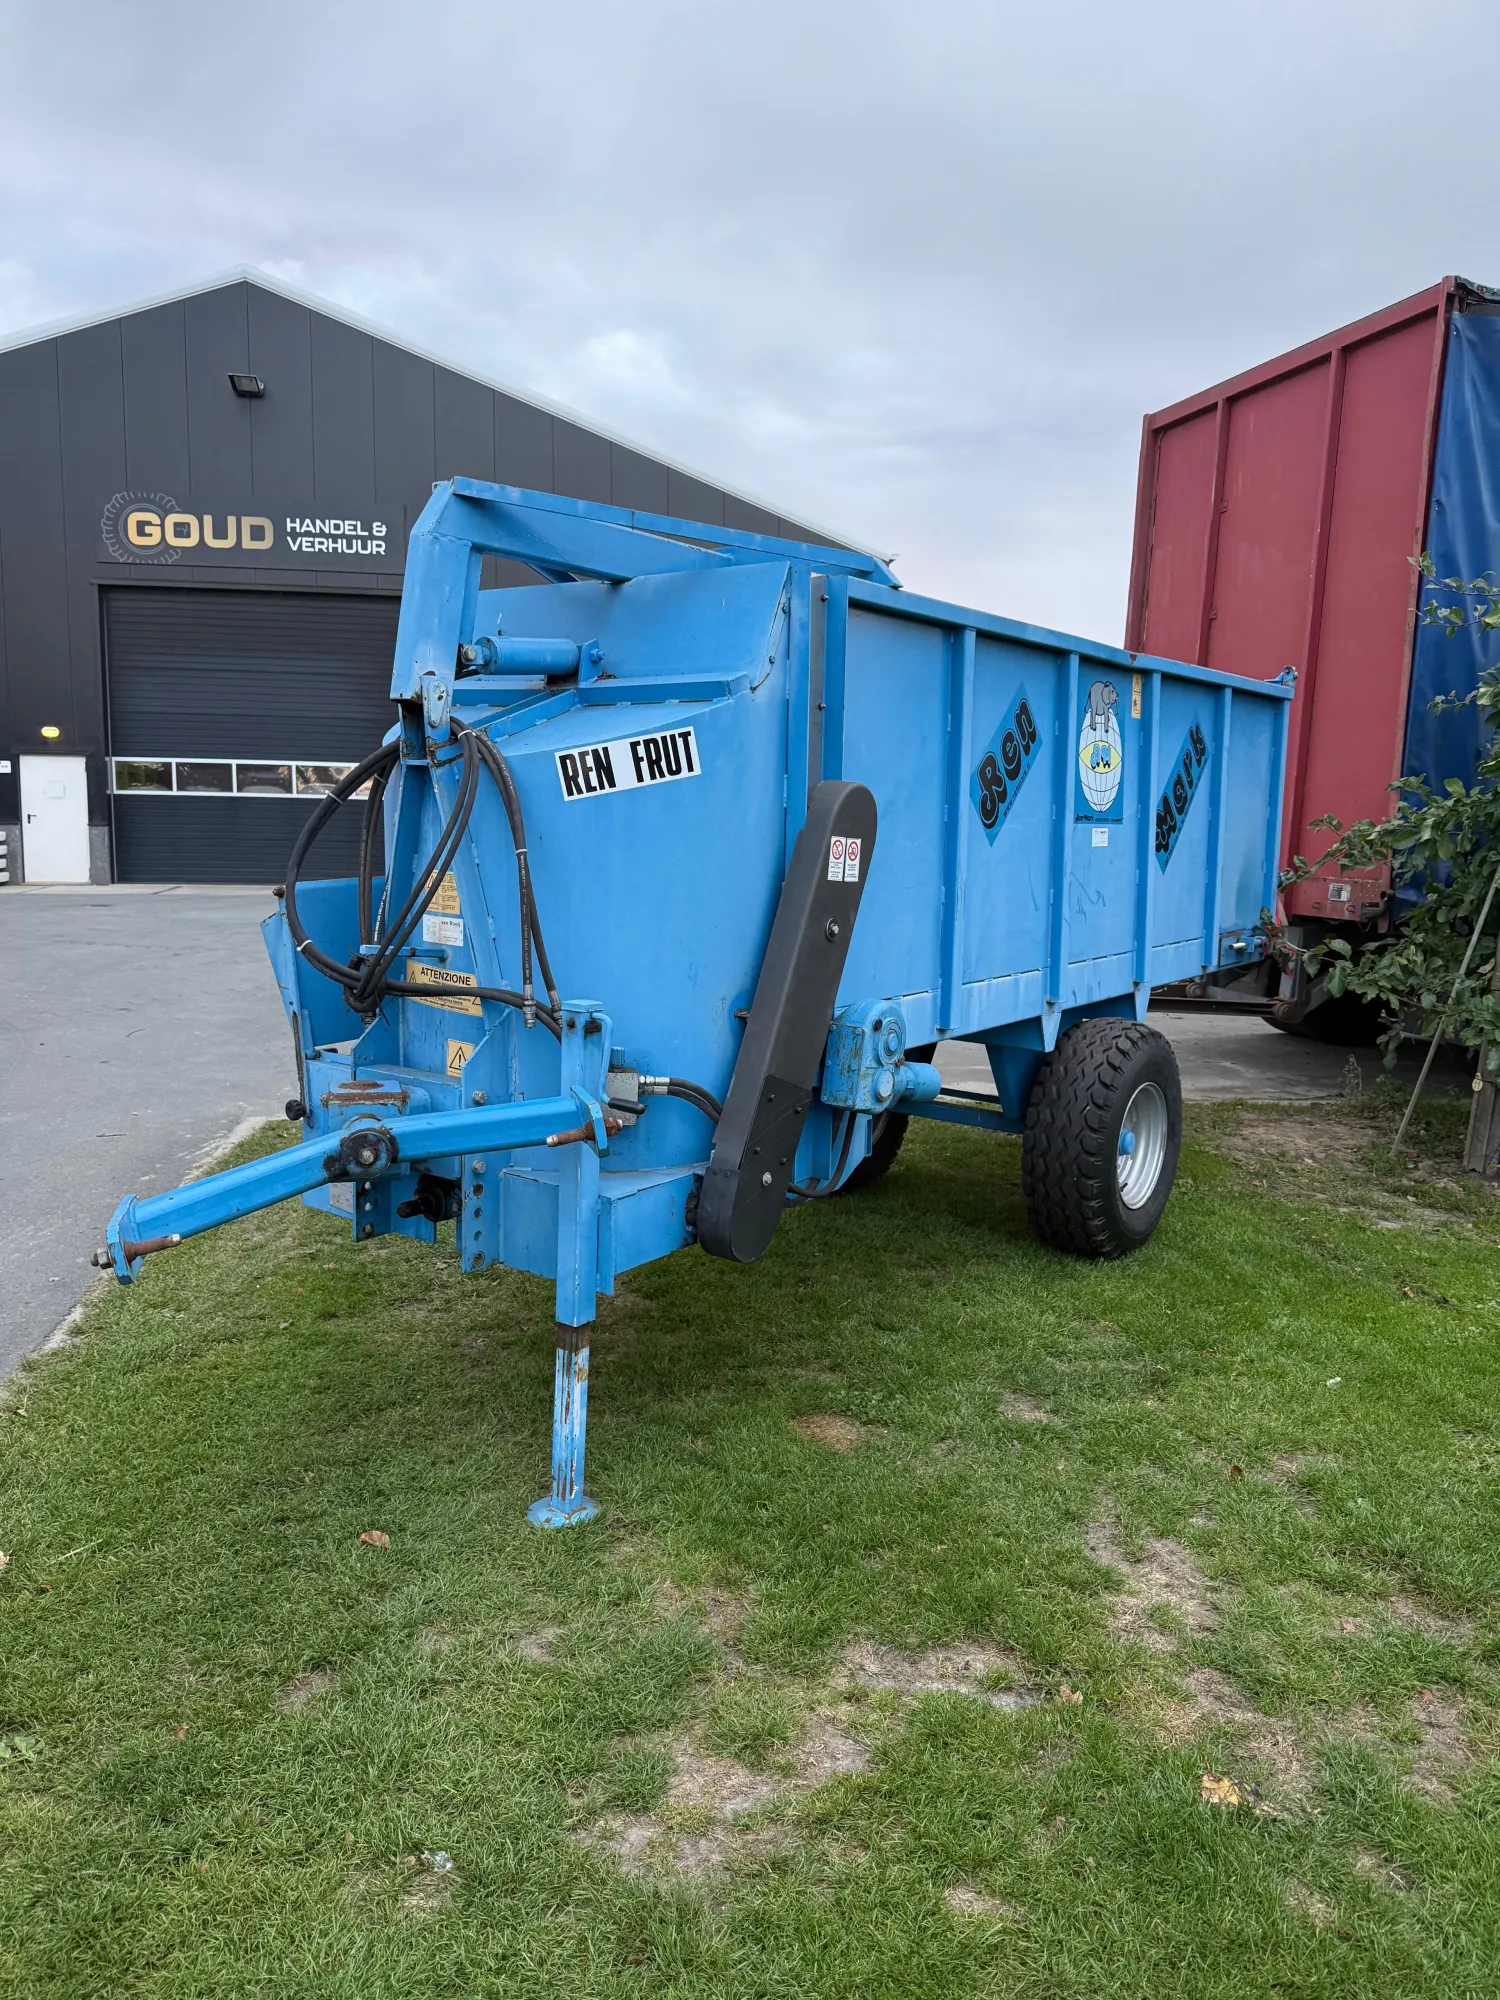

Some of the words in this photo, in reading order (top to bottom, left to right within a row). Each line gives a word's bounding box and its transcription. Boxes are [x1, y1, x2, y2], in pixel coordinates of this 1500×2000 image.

[127, 511, 274, 550] GOUD
[286, 517, 368, 535] HANDEL
[372, 520, 388, 535] &
[286, 536, 386, 555] VERHUUR
[558, 746, 617, 797] REN
[629, 730, 695, 784] FRUT
[977, 697, 1037, 829] Ren
[1155, 722, 1206, 854] Mark
[420, 966, 472, 986] ATTENZIONE
